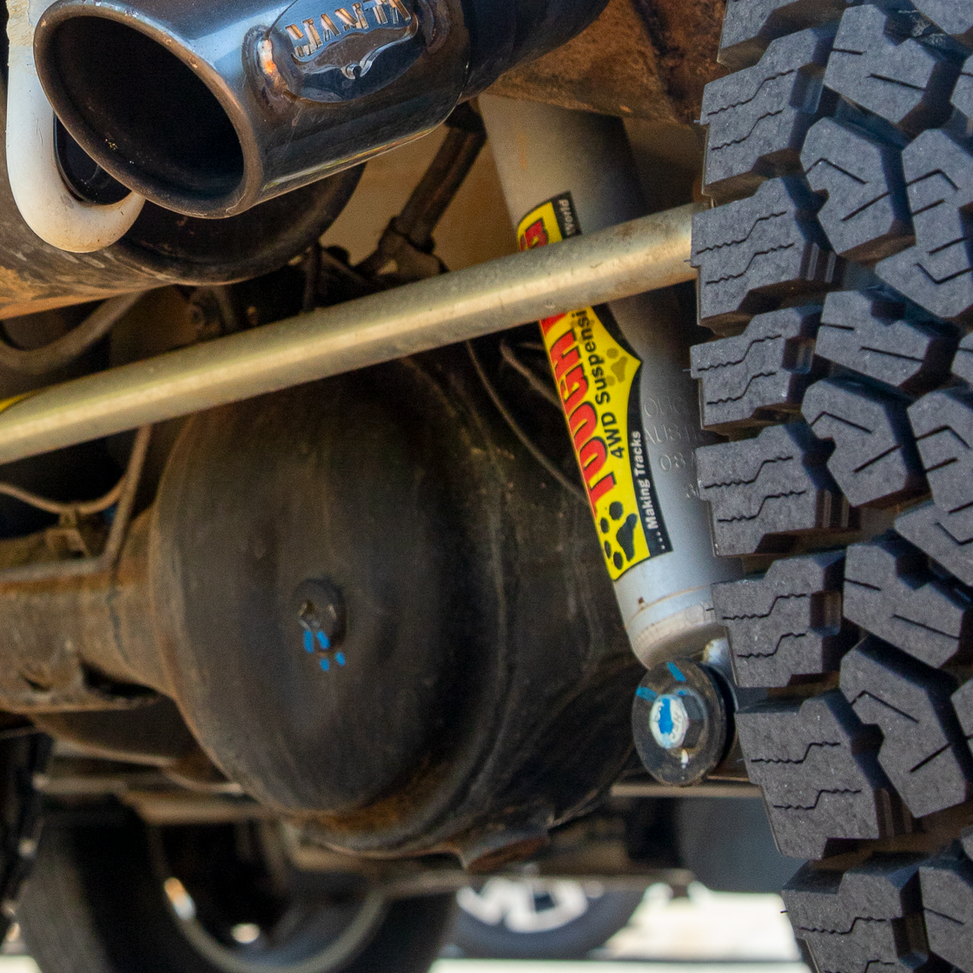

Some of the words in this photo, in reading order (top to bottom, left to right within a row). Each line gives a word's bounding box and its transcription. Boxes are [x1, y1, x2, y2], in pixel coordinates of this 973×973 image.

[549, 328, 617, 520] TOUGH
[600, 411, 626, 460] 4WD
[629, 429, 647, 477] Tracks
